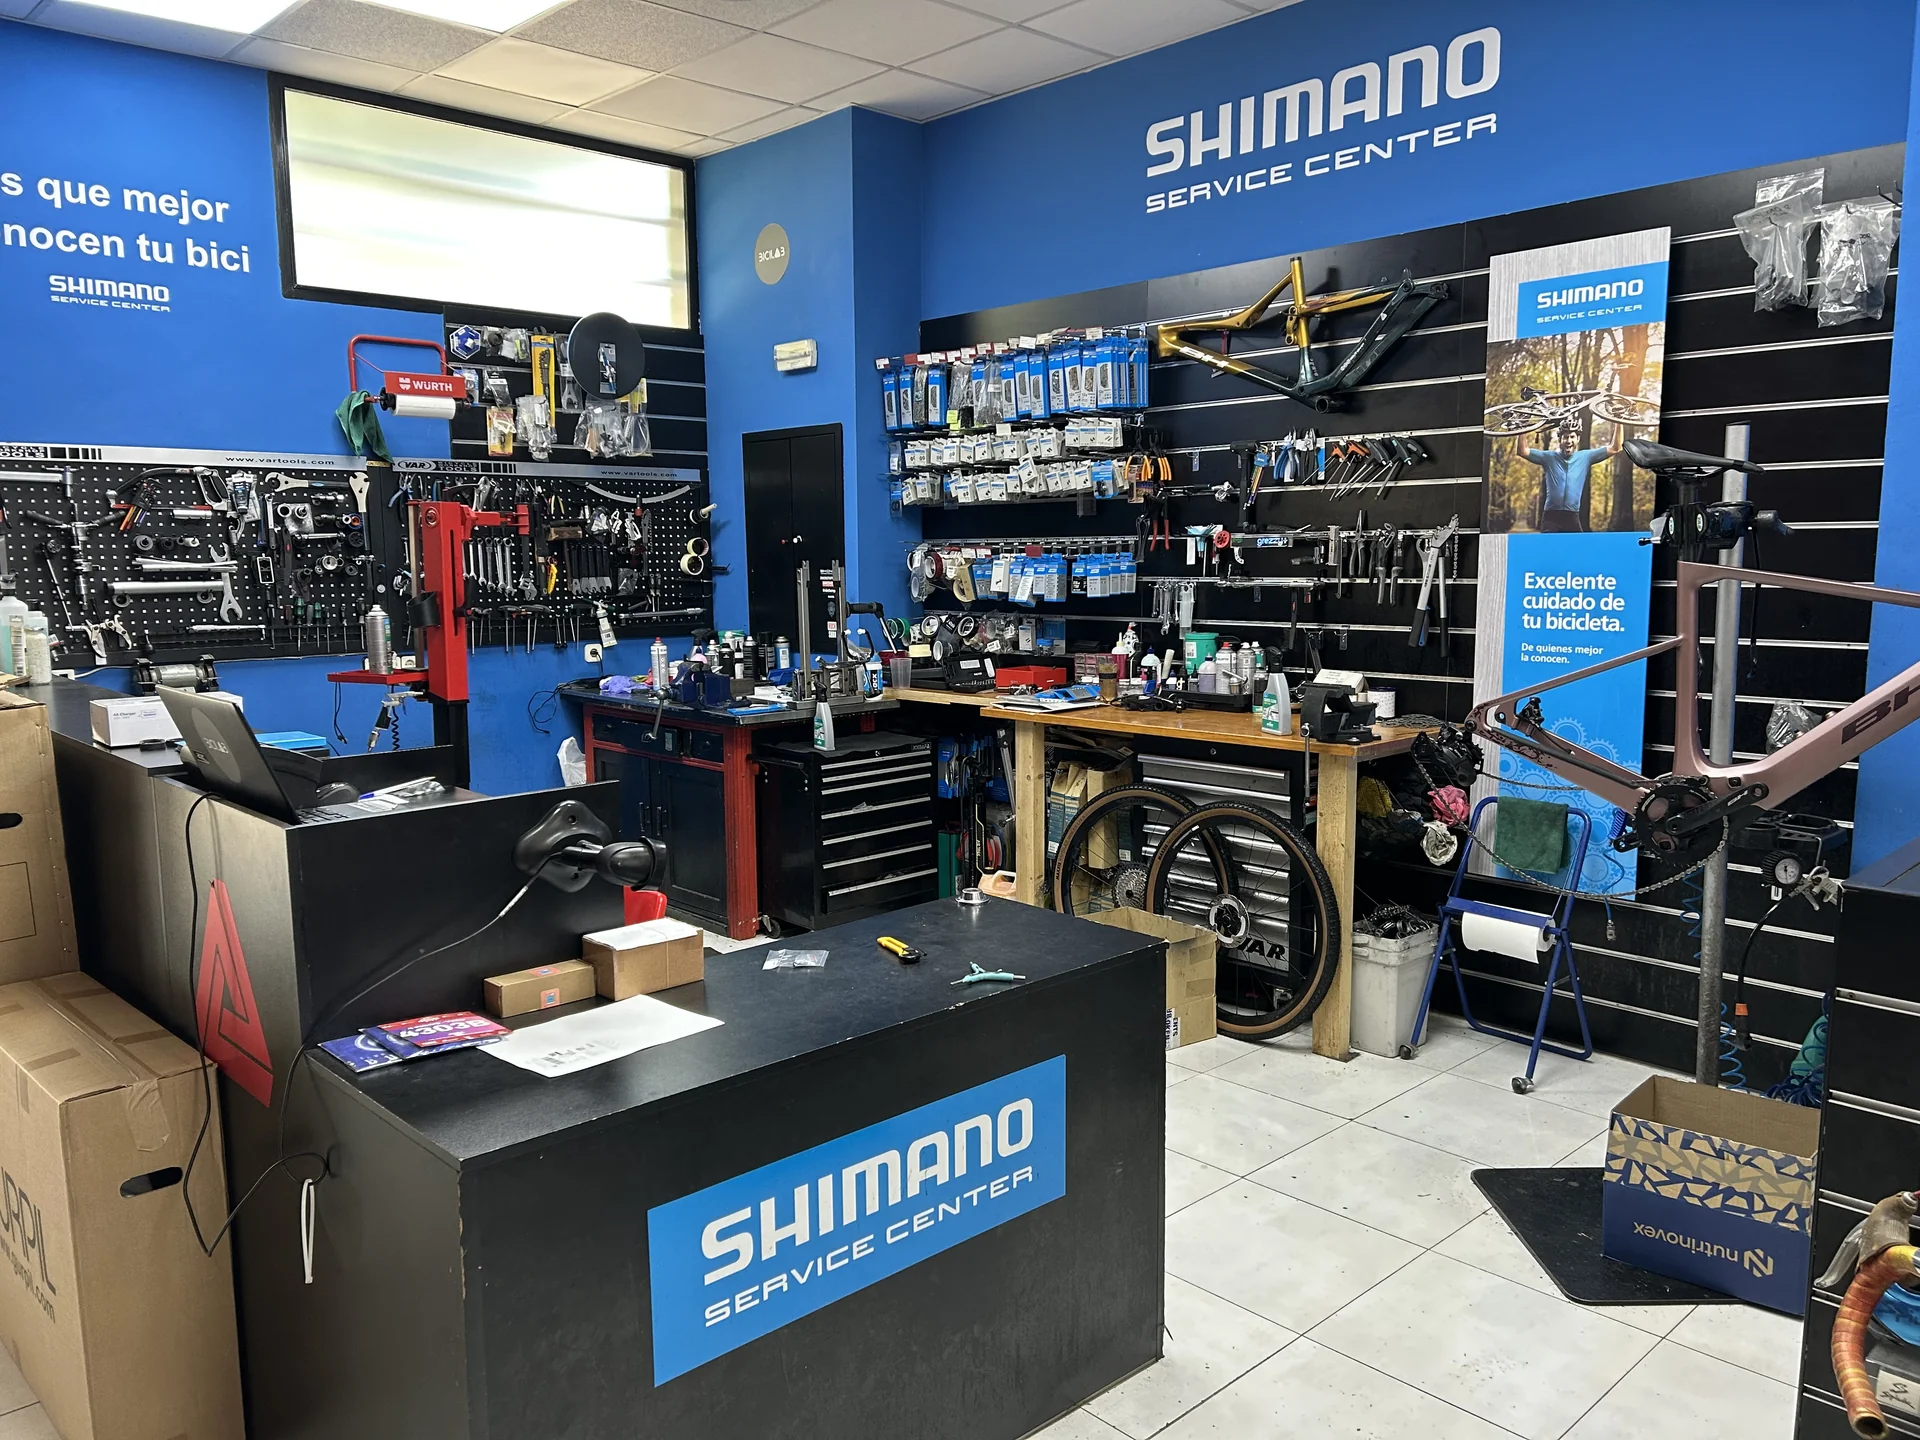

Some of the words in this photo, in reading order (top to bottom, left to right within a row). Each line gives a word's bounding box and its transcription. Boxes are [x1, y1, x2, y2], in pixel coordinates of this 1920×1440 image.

[1146, 26, 1501, 178] SHIMANO
[1146, 163, 1292, 213] SERVICE
[1304, 113, 1497, 177] CENTER
[37, 177, 110, 209] que
[123, 189, 230, 225] mejor
[0, 222, 125, 258] nocen
[136, 233, 174, 264] tu
[186, 238, 250, 273] bici
[49, 275, 170, 303] SHIMANO
[1537, 279, 1644, 309] SHIMANO
[50, 295, 109, 307] SERVICE
[111, 301, 171, 313] CENTER
[1537, 312, 1585, 324] SERVICE
[1587, 304, 1643, 317] CENTER
[412, 380, 453, 392] WÜRTH
[225, 456, 335, 465] www.vartools.com
[1524, 571, 1617, 590] Excelente
[1523, 592, 1596, 610] cuidado
[1600, 593, 1626, 611] de
[1522, 613, 1541, 629] tu
[1546, 612, 1626, 632] bicicleta.
[1521, 642, 1534, 651] De
[1536, 644, 1573, 653] quienes
[1575, 646, 1604, 656] mejor
[1521, 653, 1529, 661] la
[1531, 655, 1570, 664] conocen.
[701, 1098, 1033, 1286] SHIMANO
[705, 1234, 874, 1328] SERVICE
[886, 1165, 1033, 1244] CENTER
[1633, 1221, 1739, 1262] nutrinovex
